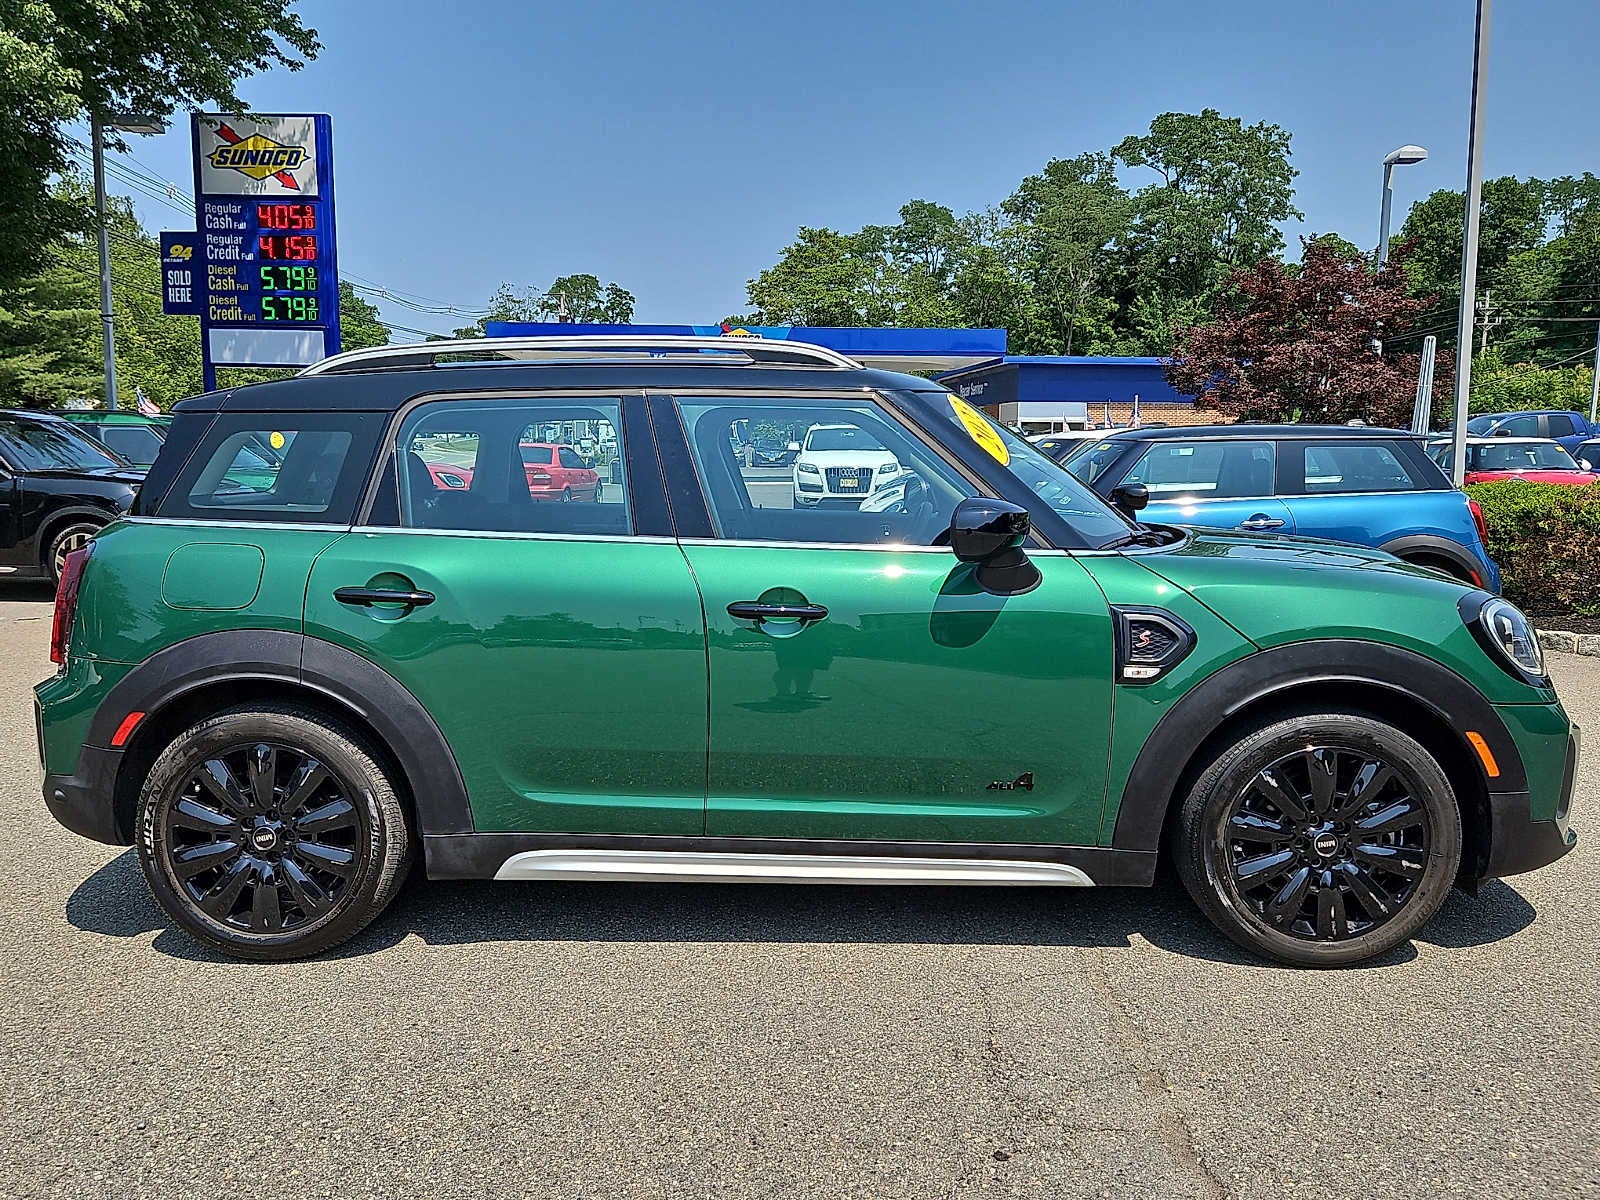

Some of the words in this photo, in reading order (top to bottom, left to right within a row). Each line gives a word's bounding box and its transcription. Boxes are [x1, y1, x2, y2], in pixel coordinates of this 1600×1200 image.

[216, 149, 300, 167] SUNOCO
[204, 203, 241, 215] Regular
[258, 205, 303, 229] 4.05
[205, 213, 233, 229] Cash
[233, 221, 247, 229] Full
[206, 233, 243, 246] Regular
[169, 244, 193, 260] 94
[206, 244, 240, 260] Credit
[241, 252, 254, 261] Full
[259, 236, 304, 260] 4.15
[207, 264, 237, 275] Diesel
[307, 266, 315, 278] 9
[167, 270, 192, 286] SOLD
[208, 275, 235, 290] Cash
[236, 283, 249, 291] Full
[260, 266, 305, 290] 5.79
[168, 287, 193, 303] HERE
[208, 294, 238, 305] Diesel
[308, 297, 316, 308] 9
[209, 305, 242, 321] Credit
[243, 313, 256, 321] Full
[262, 297, 306, 321] 5.79
[1135, 630, 1151, 648] S
[255, 834, 273, 842] MINI
[1317, 840, 1335, 848] MINI
